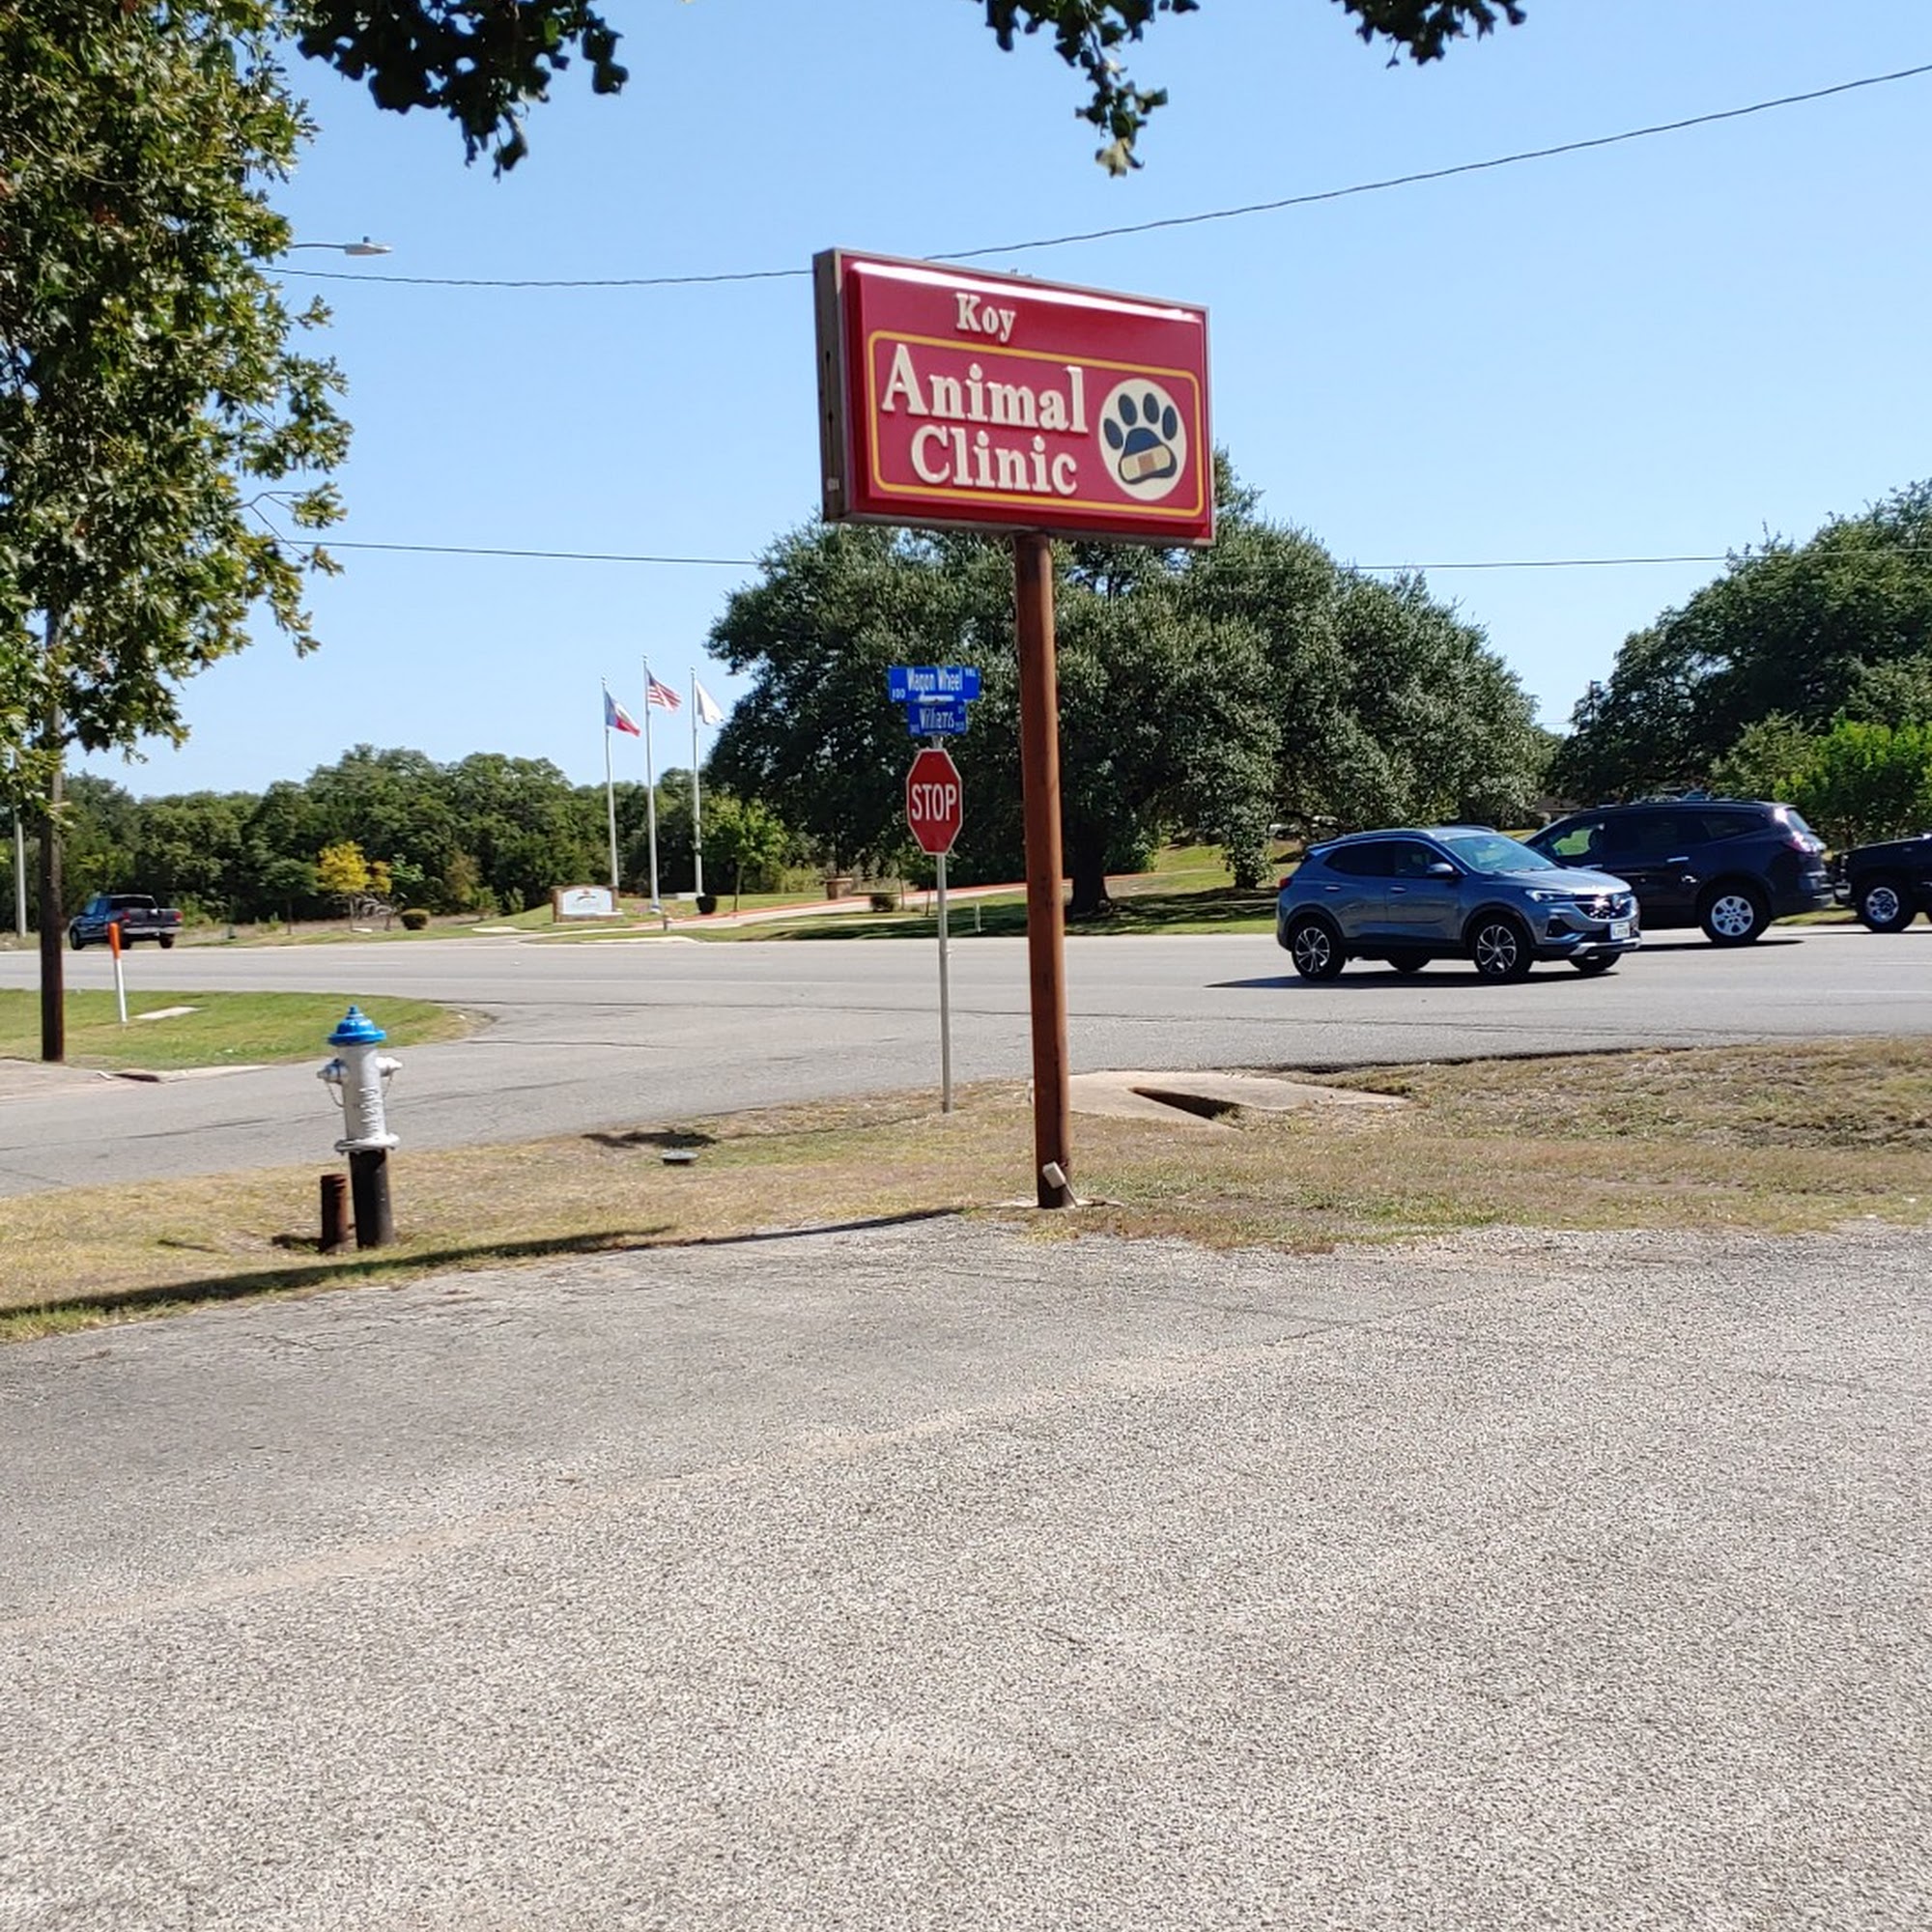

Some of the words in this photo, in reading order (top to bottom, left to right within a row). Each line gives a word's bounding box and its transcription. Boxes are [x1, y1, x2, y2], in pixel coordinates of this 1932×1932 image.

[955, 292, 1016, 343] Koy
[882, 344, 1089, 434] Animal
[911, 425, 1078, 496] Clinic
[906, 667, 936, 697] Wagon
[937, 667, 963, 692] Wheel
[911, 783, 957, 821] STOP
